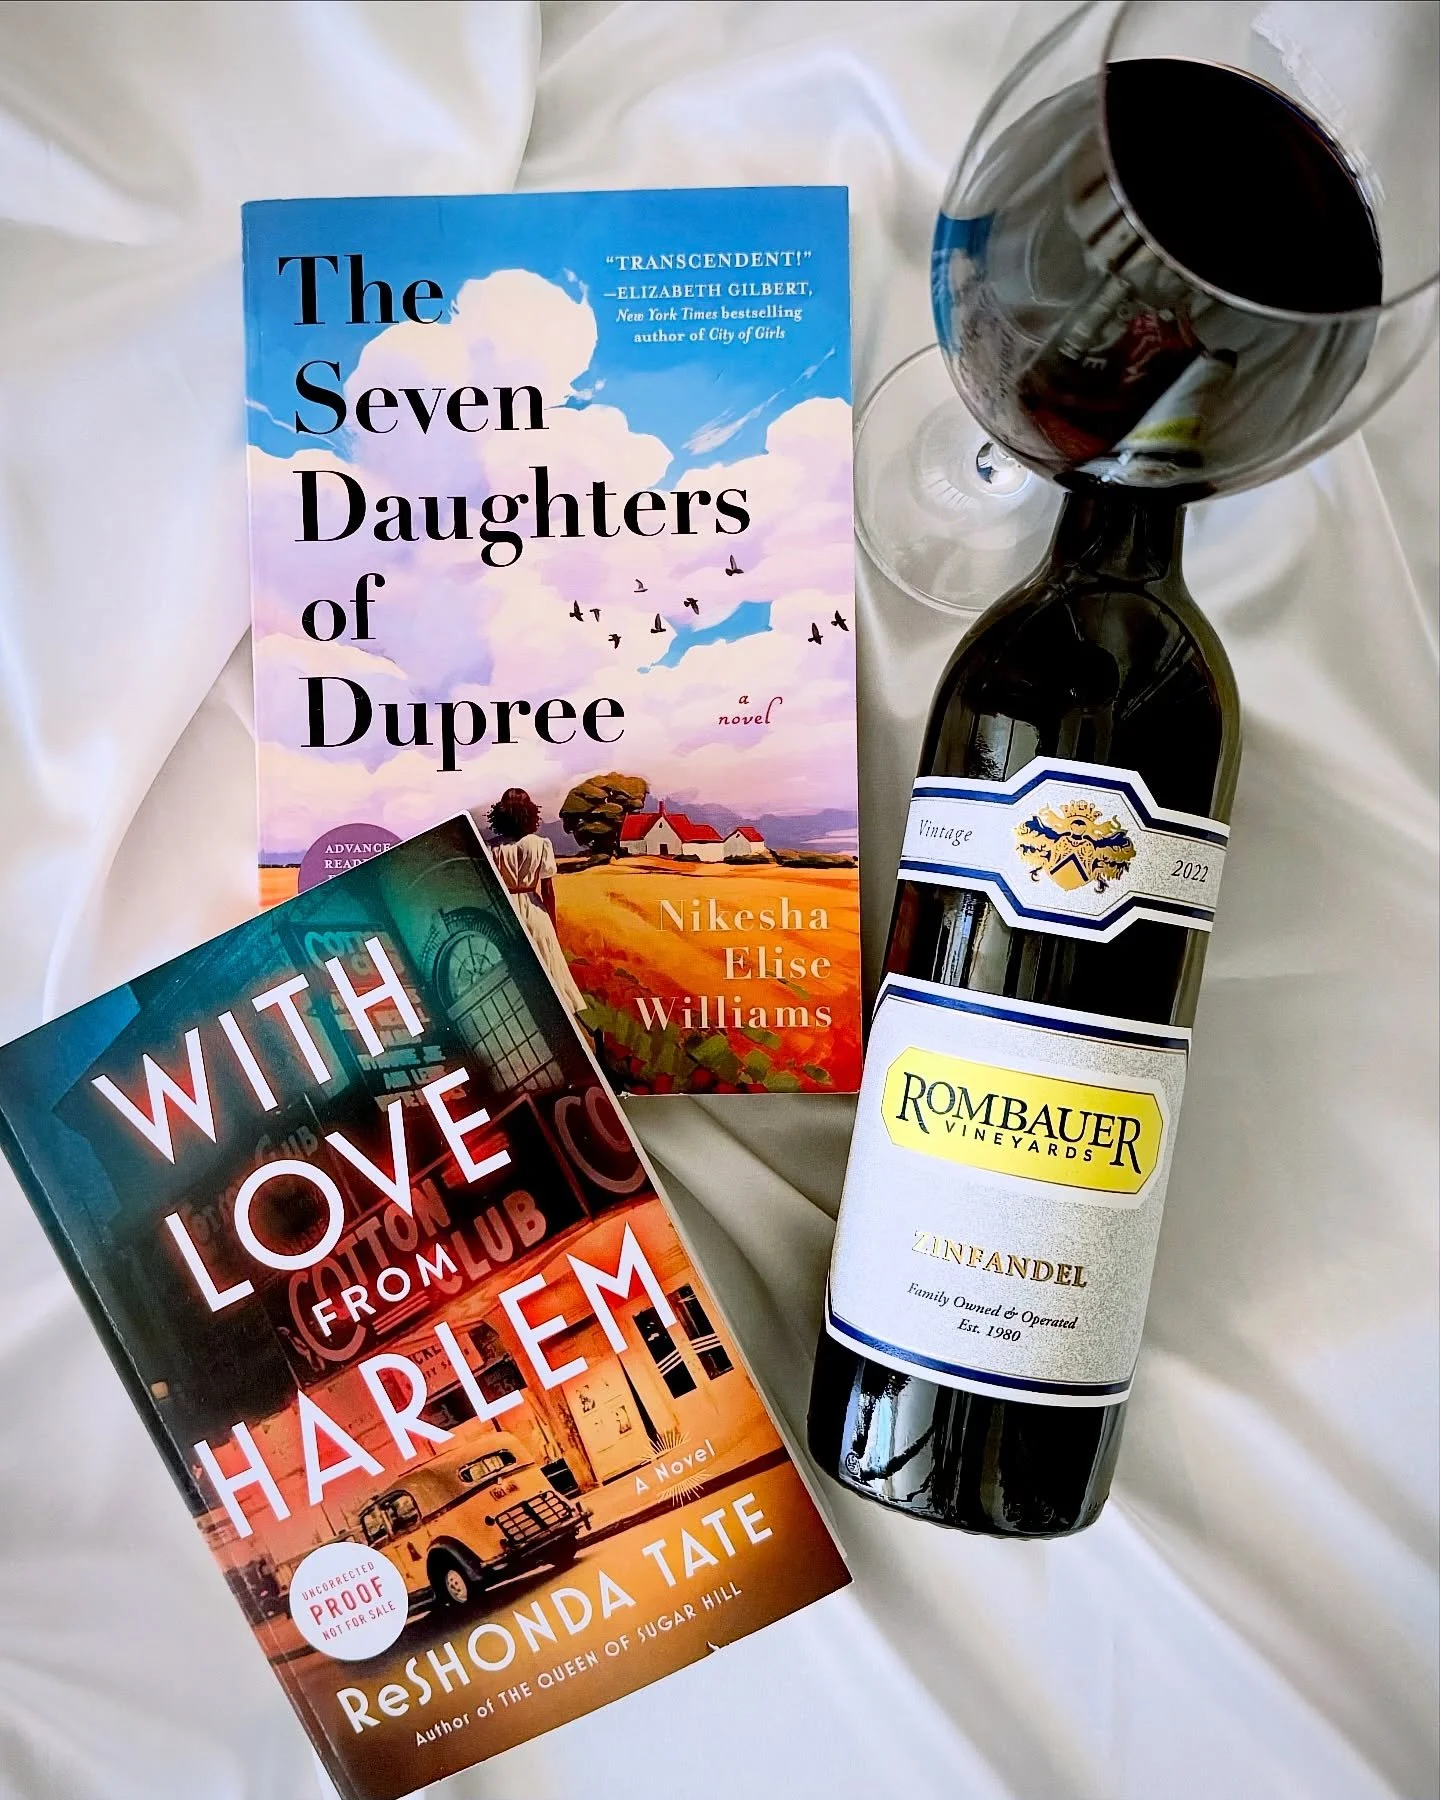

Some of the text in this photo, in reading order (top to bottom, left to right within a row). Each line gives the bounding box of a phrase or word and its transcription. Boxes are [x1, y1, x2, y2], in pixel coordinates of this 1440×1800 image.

[278, 254, 443, 326] The
[616, 304, 802, 323] New York Times bestselling
[727, 281, 813, 297] GILBERT,
[634, 326, 785, 344] author of City of Girls
[295, 360, 549, 435] Seven
[293, 466, 750, 567] Daughters
[302, 572, 385, 642] of
[299, 676, 625, 772] Dupree
[718, 695, 783, 725] novel
[738, 693, 750, 706] a
[324, 859, 367, 869] READ
[325, 843, 391, 854] ADVANCE
[919, 819, 1209, 883] Vintage 2022
[656, 896, 830, 932] Nikesha
[722, 946, 832, 980] Elise
[632, 995, 832, 1031] Williams
[92, 936, 425, 1164] WITH
[896, 1071, 1142, 1175] ROMBAUER
[945, 1120, 1093, 1162] VINEYARDS
[164, 1066, 511, 1312] LOVE
[289, 1178, 450, 1361] COTTON
[911, 1230, 1088, 1288] ZINFANDEL
[311, 1242, 458, 1337] FROM
[907, 1282, 1078, 1330] Family Owned & Operated
[957, 1318, 1021, 1342] Est. 1980
[194, 1221, 677, 1538] HARLEM
[634, 1439, 716, 1495] A Novel
[302, 1561, 375, 1601] UNCORRECTED
[309, 1576, 383, 1626] PROOF
[322, 1601, 396, 1641] NOT FOR SALE
[336, 1492, 773, 1734] ReSHONDA TATE
[415, 1583, 742, 1747] Author of THE QUEEN OF SUGAR HILL
